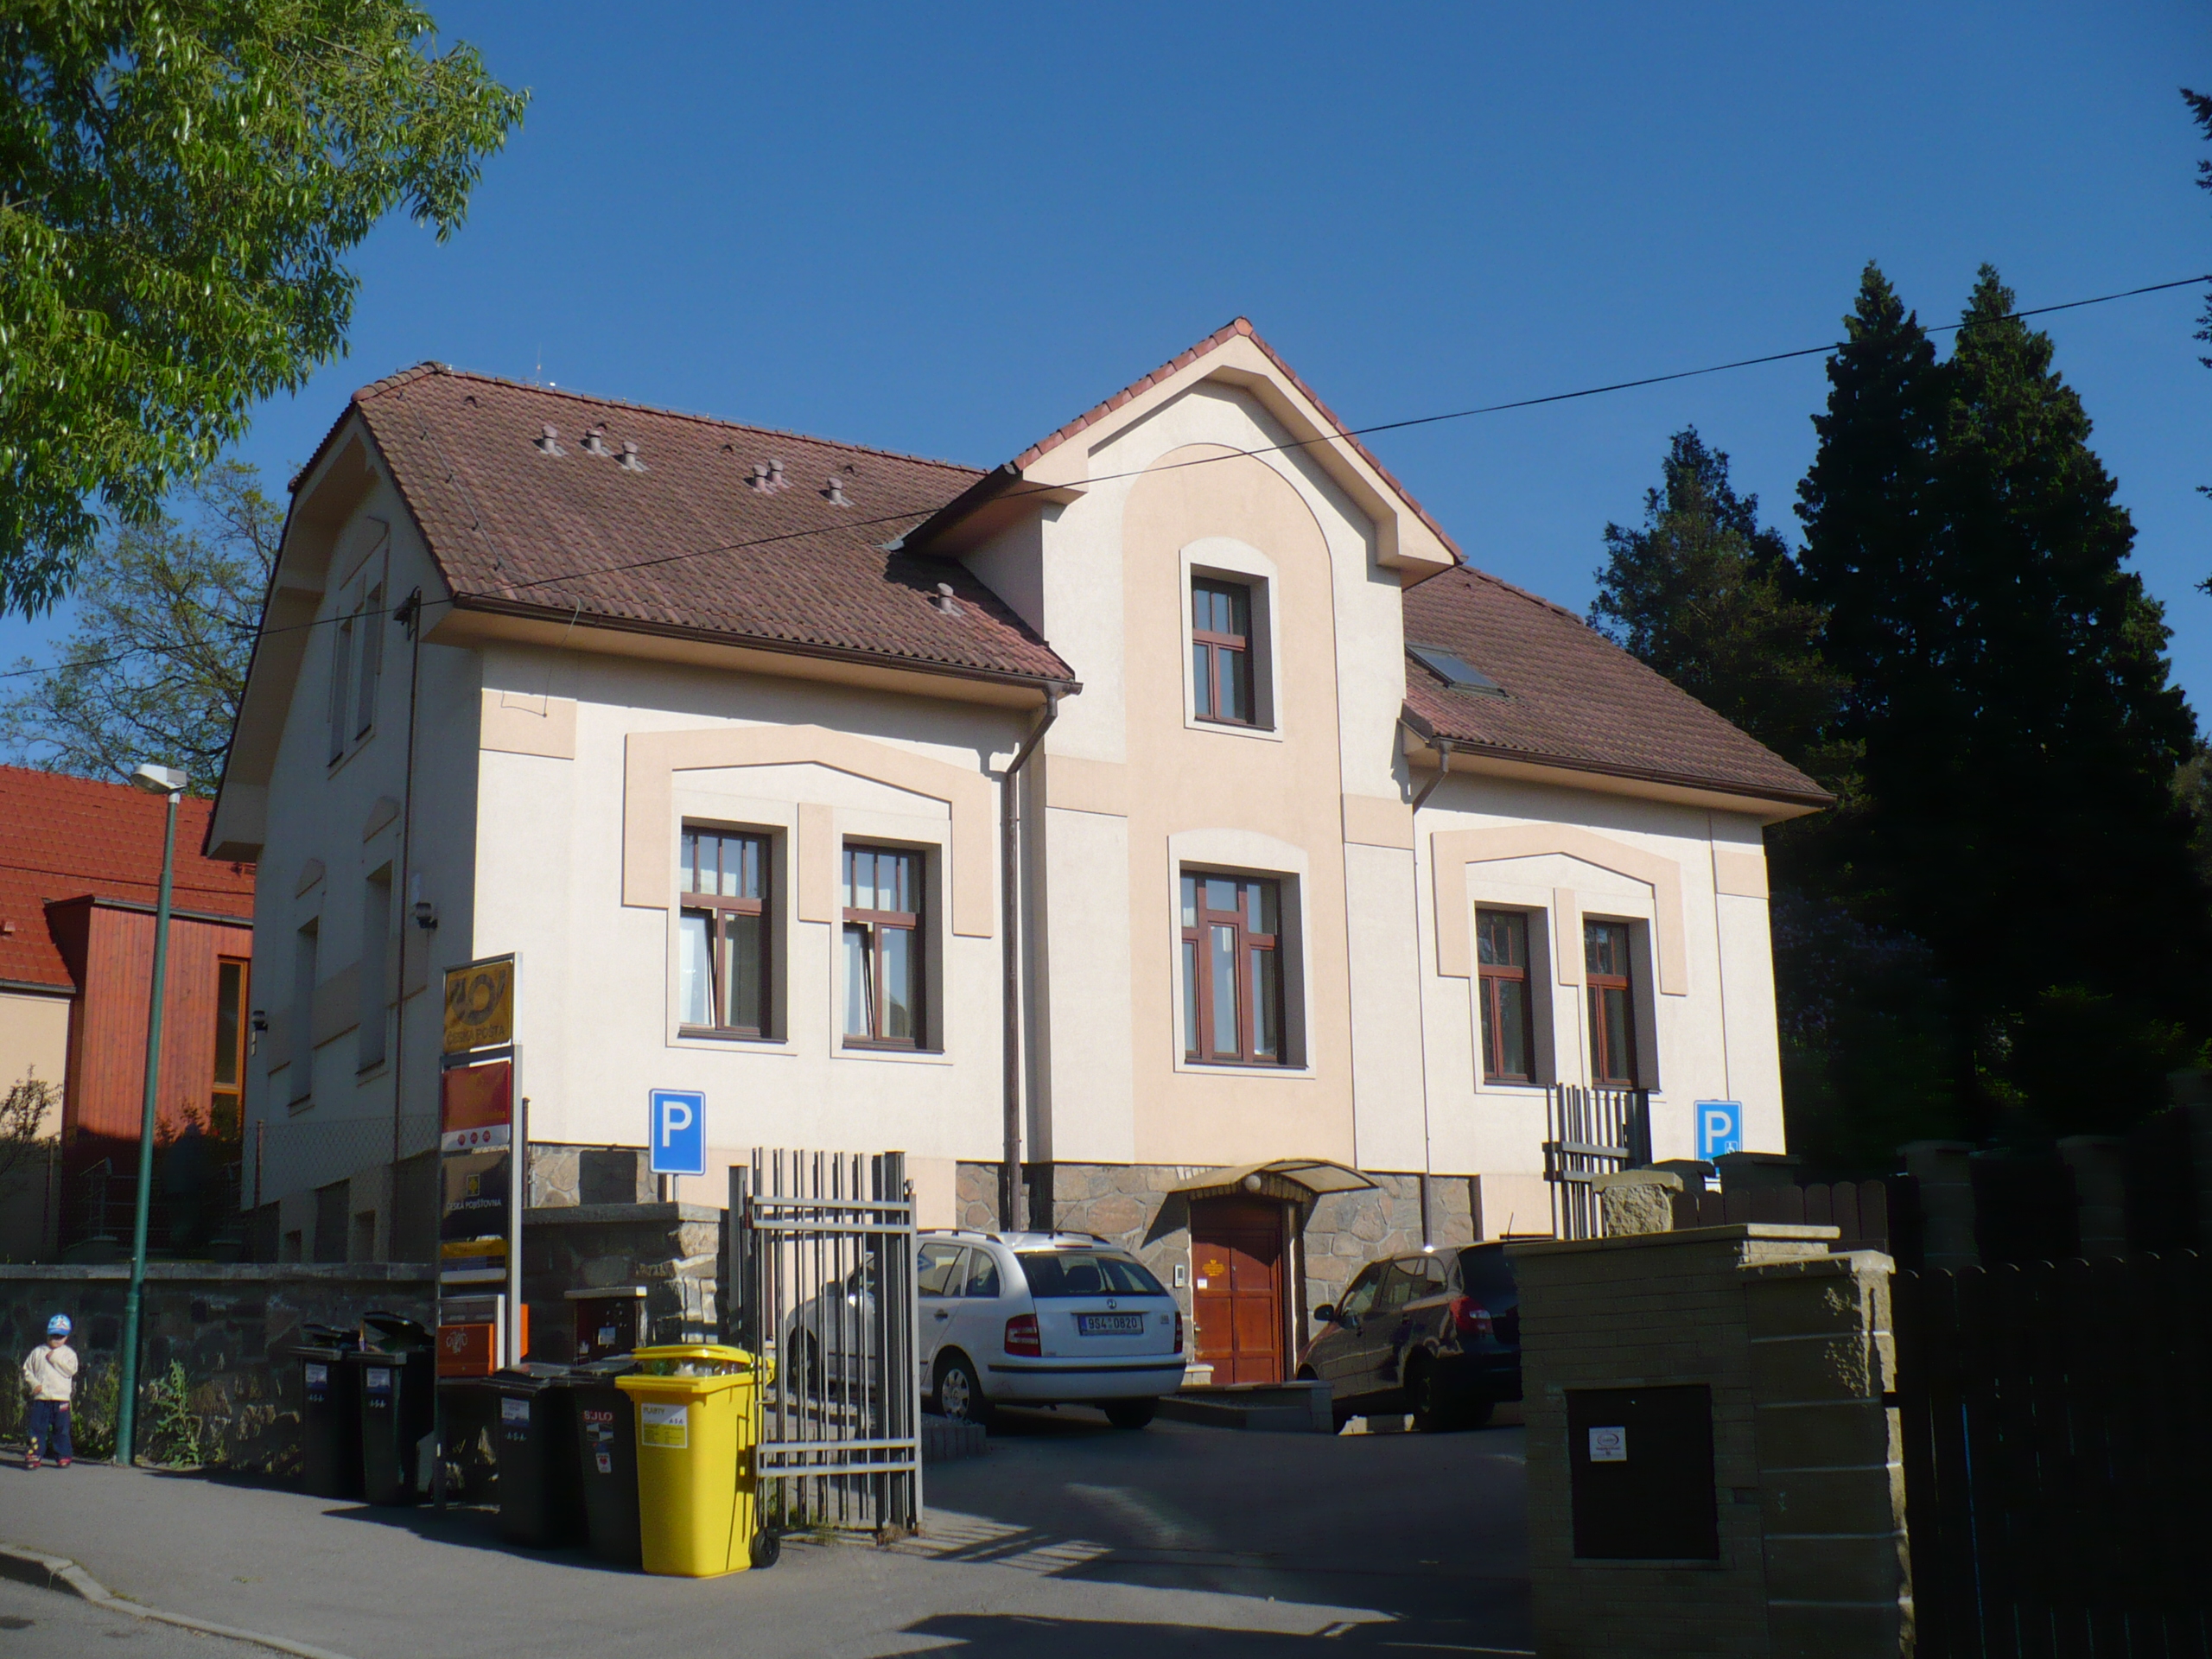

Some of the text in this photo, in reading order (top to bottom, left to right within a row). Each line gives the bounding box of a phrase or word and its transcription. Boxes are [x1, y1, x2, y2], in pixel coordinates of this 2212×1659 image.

[662, 1100, 693, 1147] P
[1705, 1110, 1732, 1154] P
[1088, 1317, 1137, 1330] 9S4 0820
